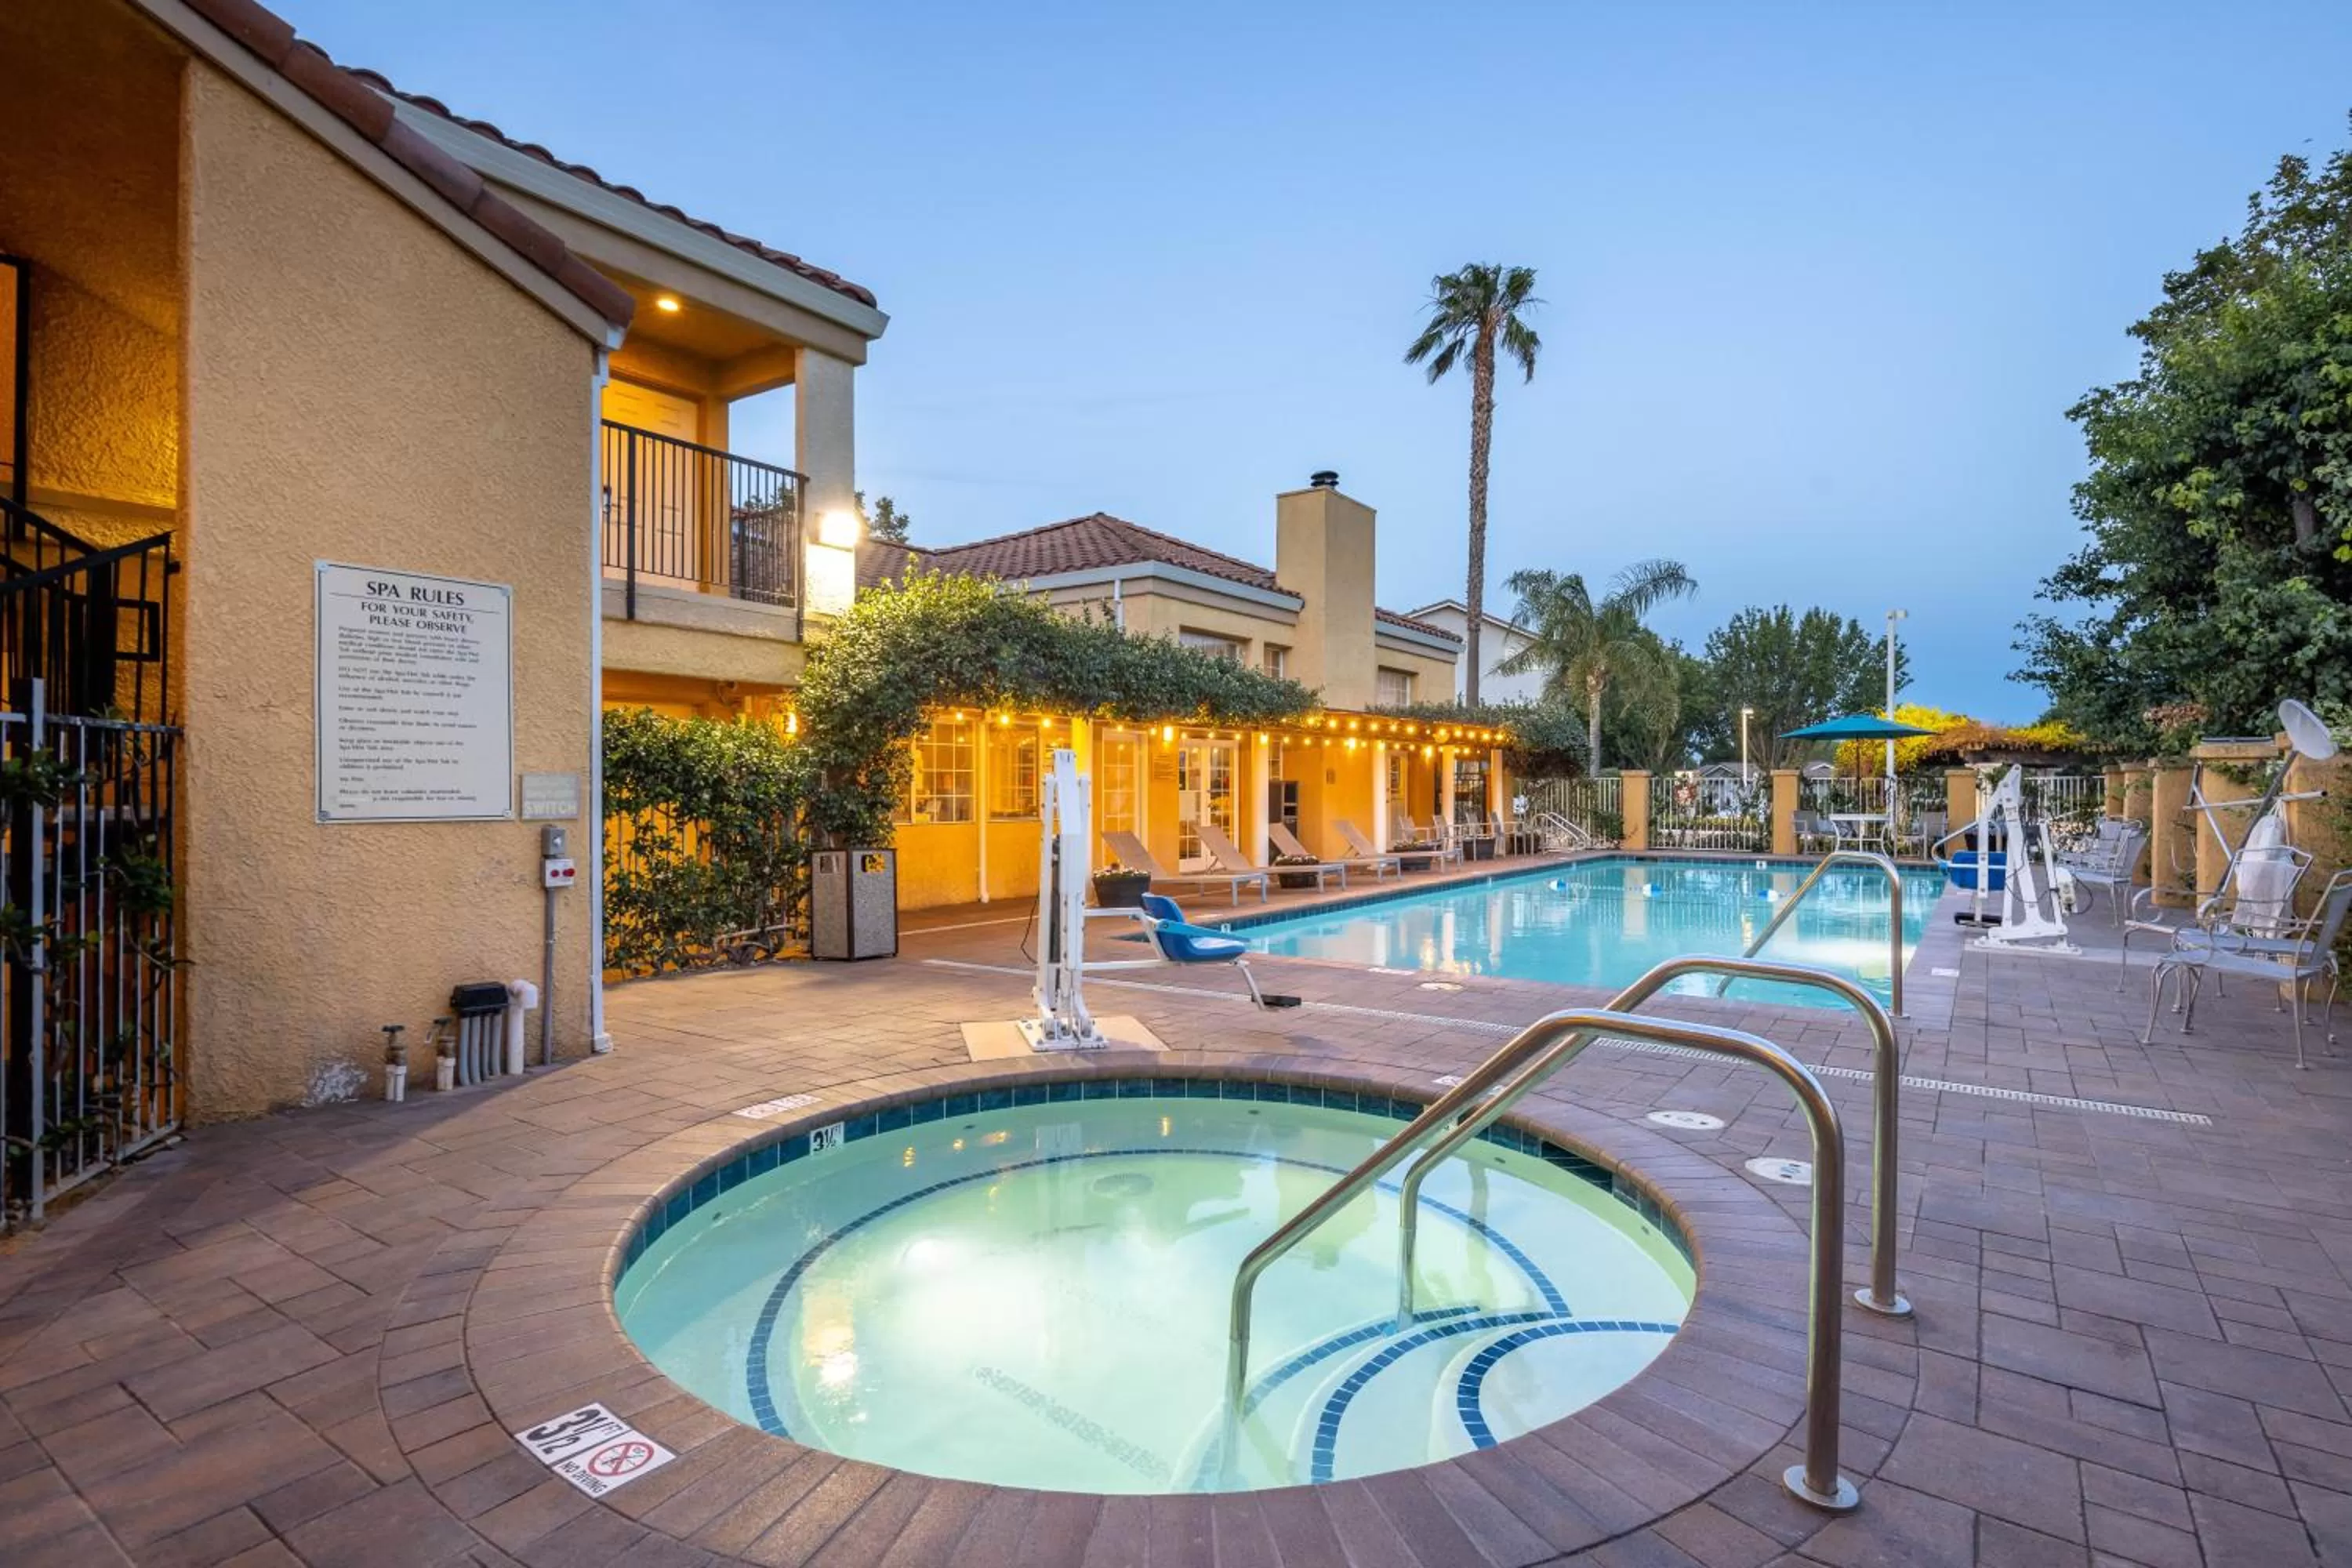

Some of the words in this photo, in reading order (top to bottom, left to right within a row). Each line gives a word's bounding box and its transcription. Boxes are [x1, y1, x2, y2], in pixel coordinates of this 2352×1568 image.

[366, 581, 401, 598] SPA
[410, 586, 465, 606] RULES
[361, 601, 387, 613] FOR
[393, 604, 427, 618] YOUR
[369, 614, 412, 628] PLEASE
[558, 1461, 580, 1472] NO
[572, 1469, 608, 1494] DIVING
